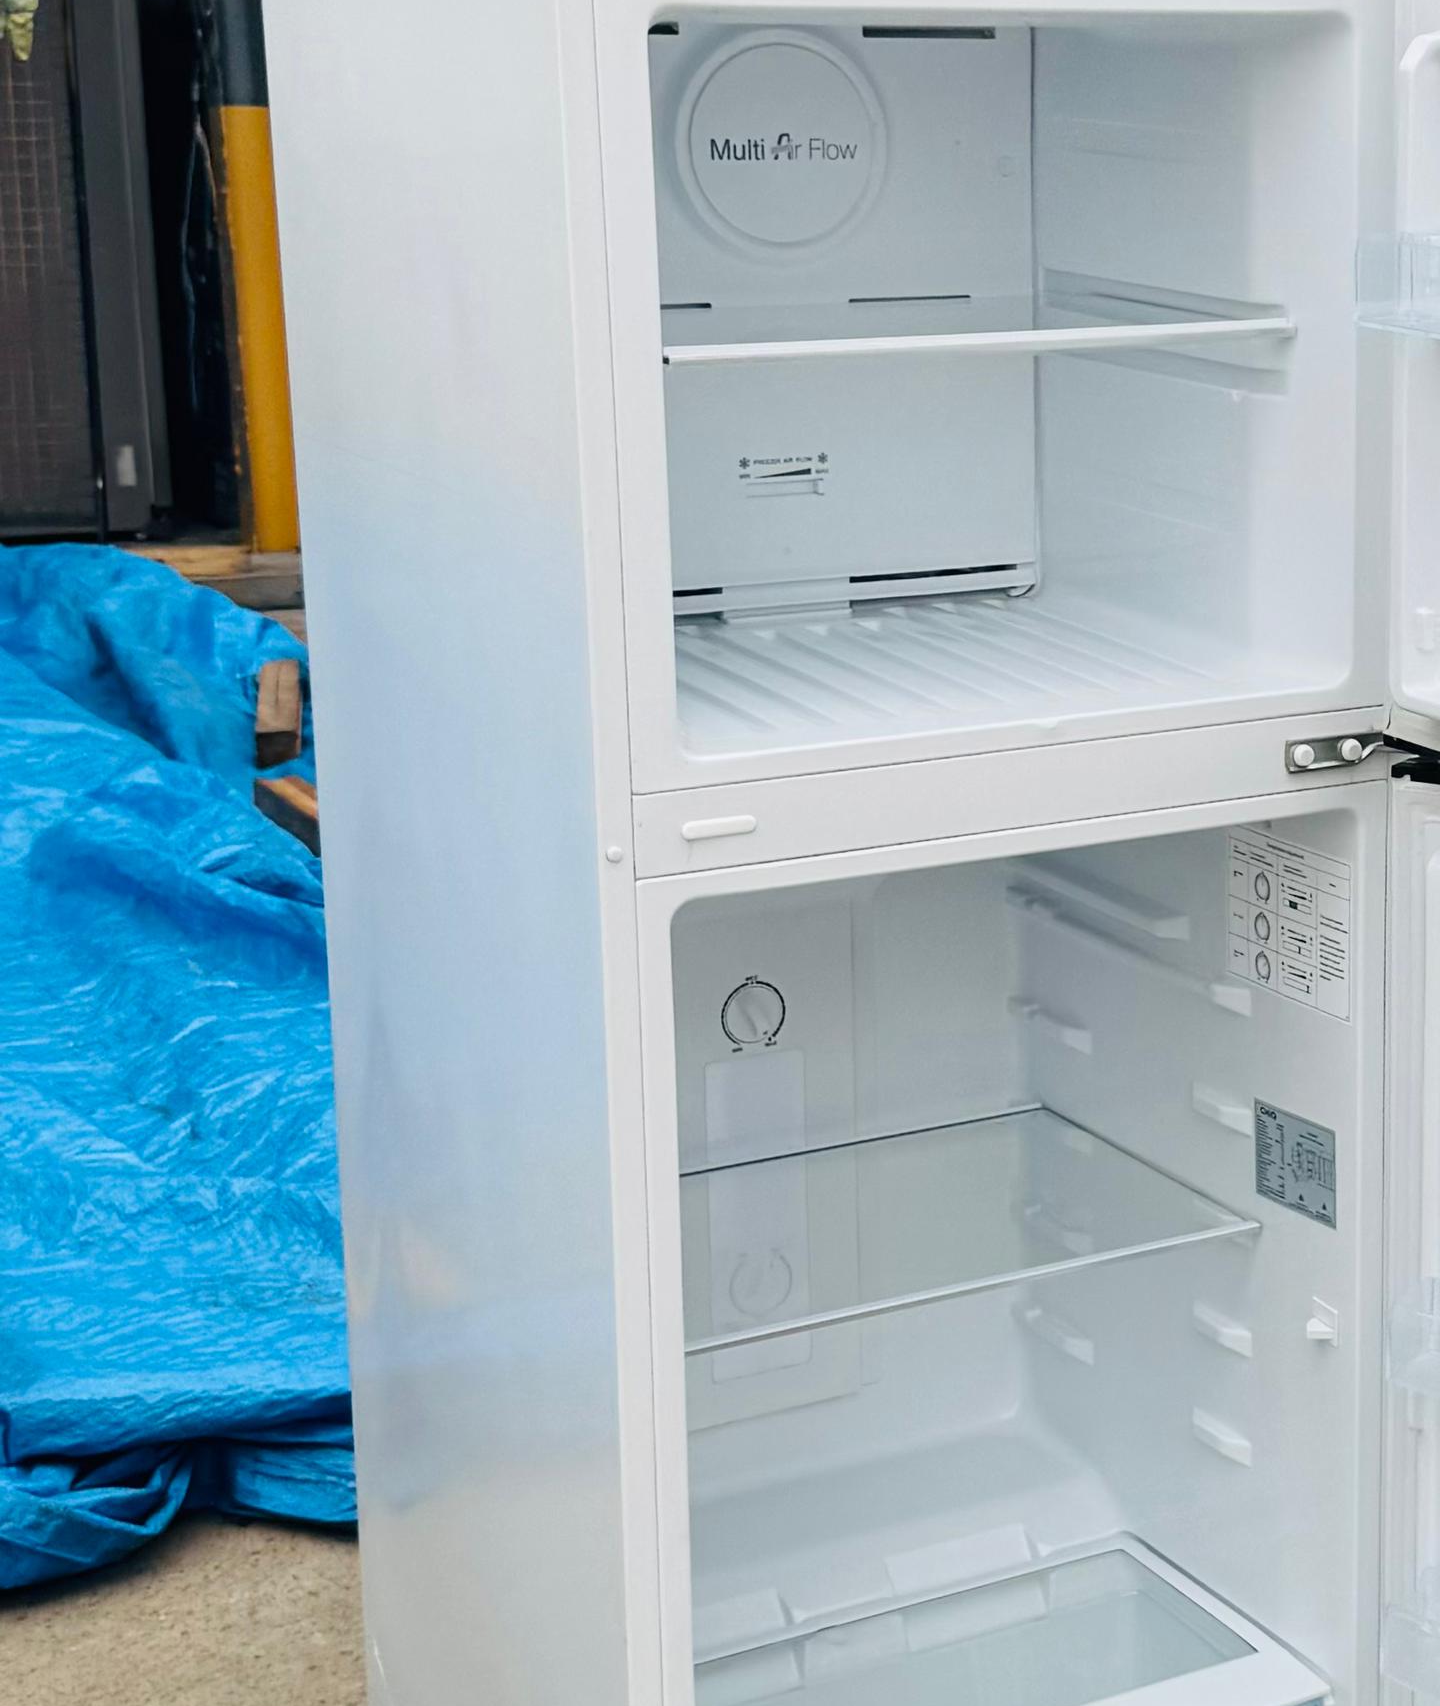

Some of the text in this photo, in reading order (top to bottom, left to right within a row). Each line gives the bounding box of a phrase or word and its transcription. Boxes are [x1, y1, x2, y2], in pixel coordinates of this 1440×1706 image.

[710, 133, 857, 160] Multi Air Flow
